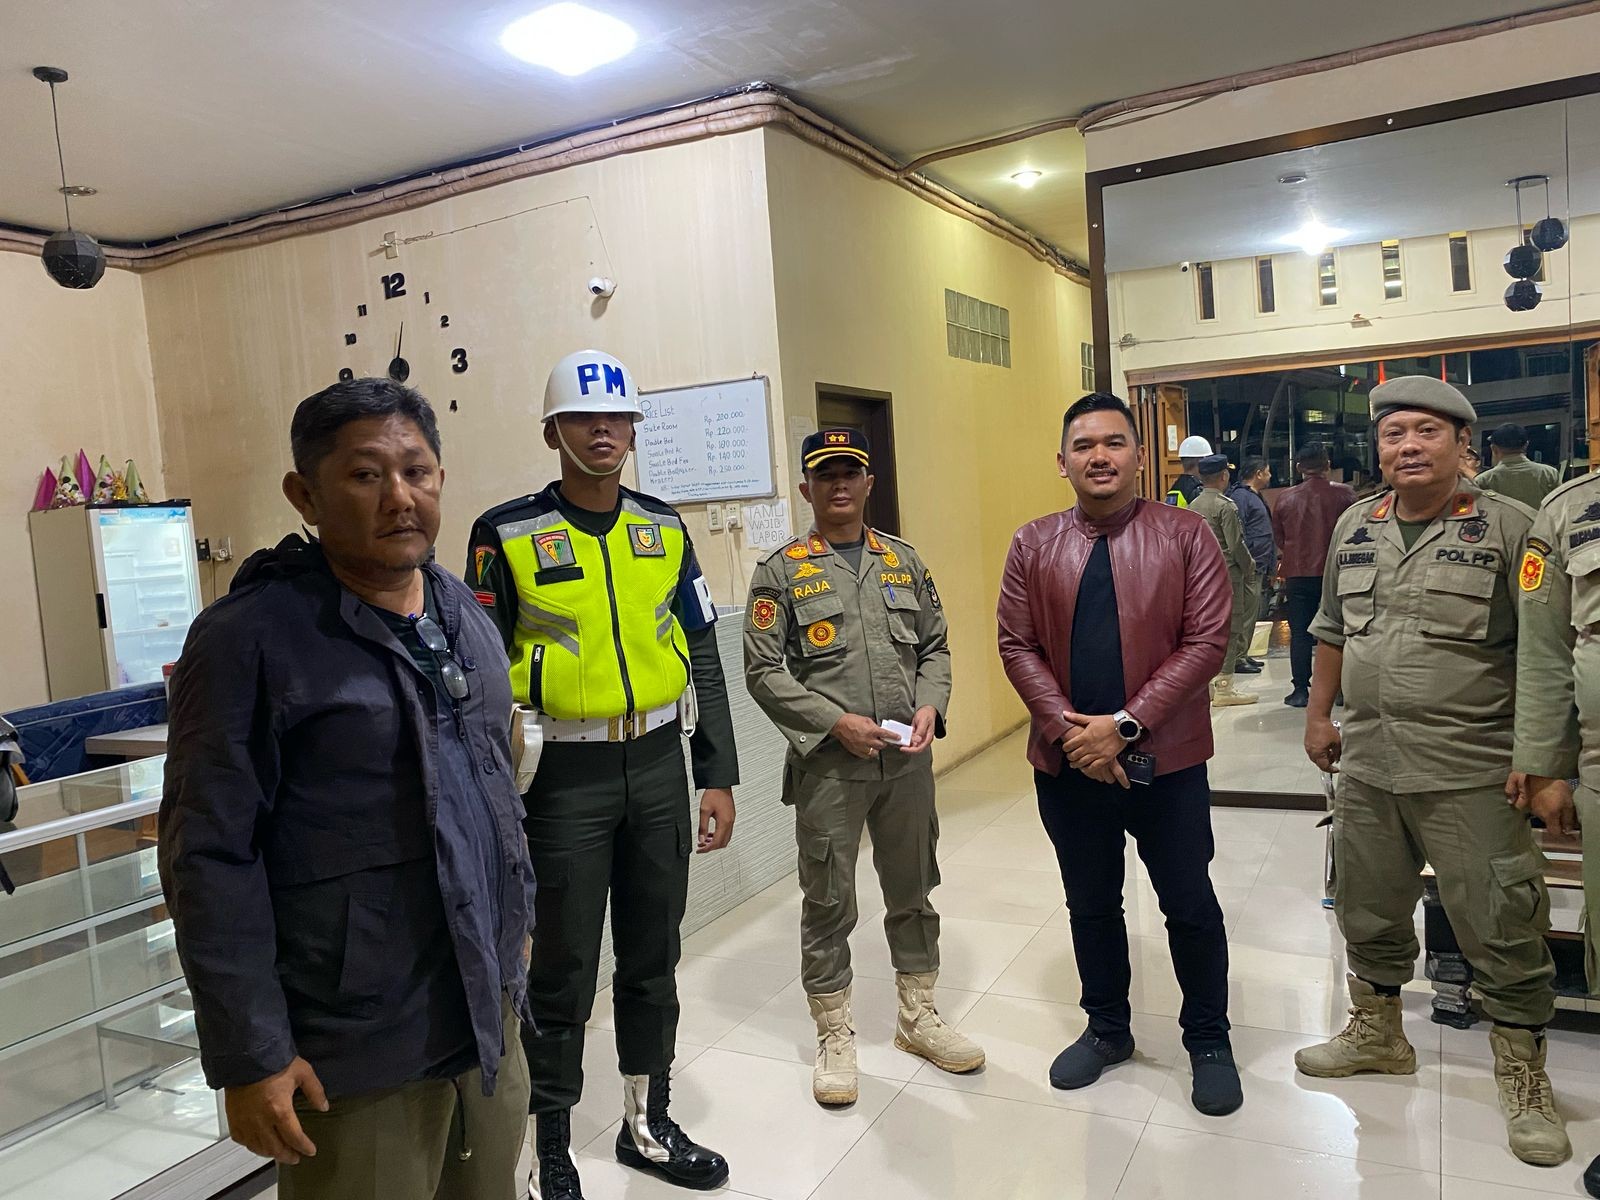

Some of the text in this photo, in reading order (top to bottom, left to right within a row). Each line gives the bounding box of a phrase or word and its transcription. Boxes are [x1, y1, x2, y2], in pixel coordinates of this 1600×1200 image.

[381, 272, 407, 300] 12
[424, 292, 430, 304] 1
[358, 304, 368, 317] 11
[440, 315, 450, 328] 2
[344, 333, 357, 346] 10
[451, 348, 468, 373] 3
[577, 363, 626, 397] PM
[449, 400, 458, 412] 4
[747, 503, 784, 520] TAMU
[753, 530, 785, 545] LAPOR
[1435, 549, 1496, 566] POL PP
[793, 580, 831, 600] RAJA
